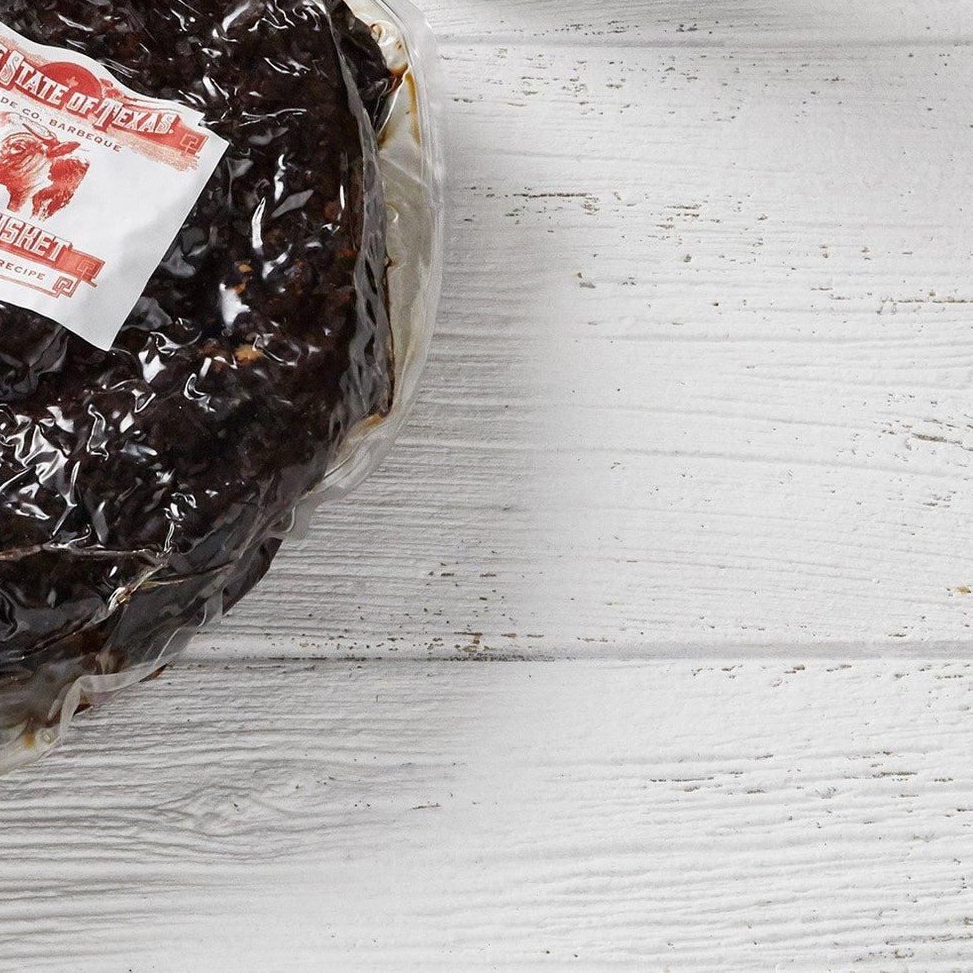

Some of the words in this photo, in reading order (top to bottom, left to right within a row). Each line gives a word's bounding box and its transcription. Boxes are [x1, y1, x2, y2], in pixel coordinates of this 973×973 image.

[65, 91, 99, 114] OF
[22, 108, 43, 122] CO.
[49, 119, 123, 153] BARBEQUE
